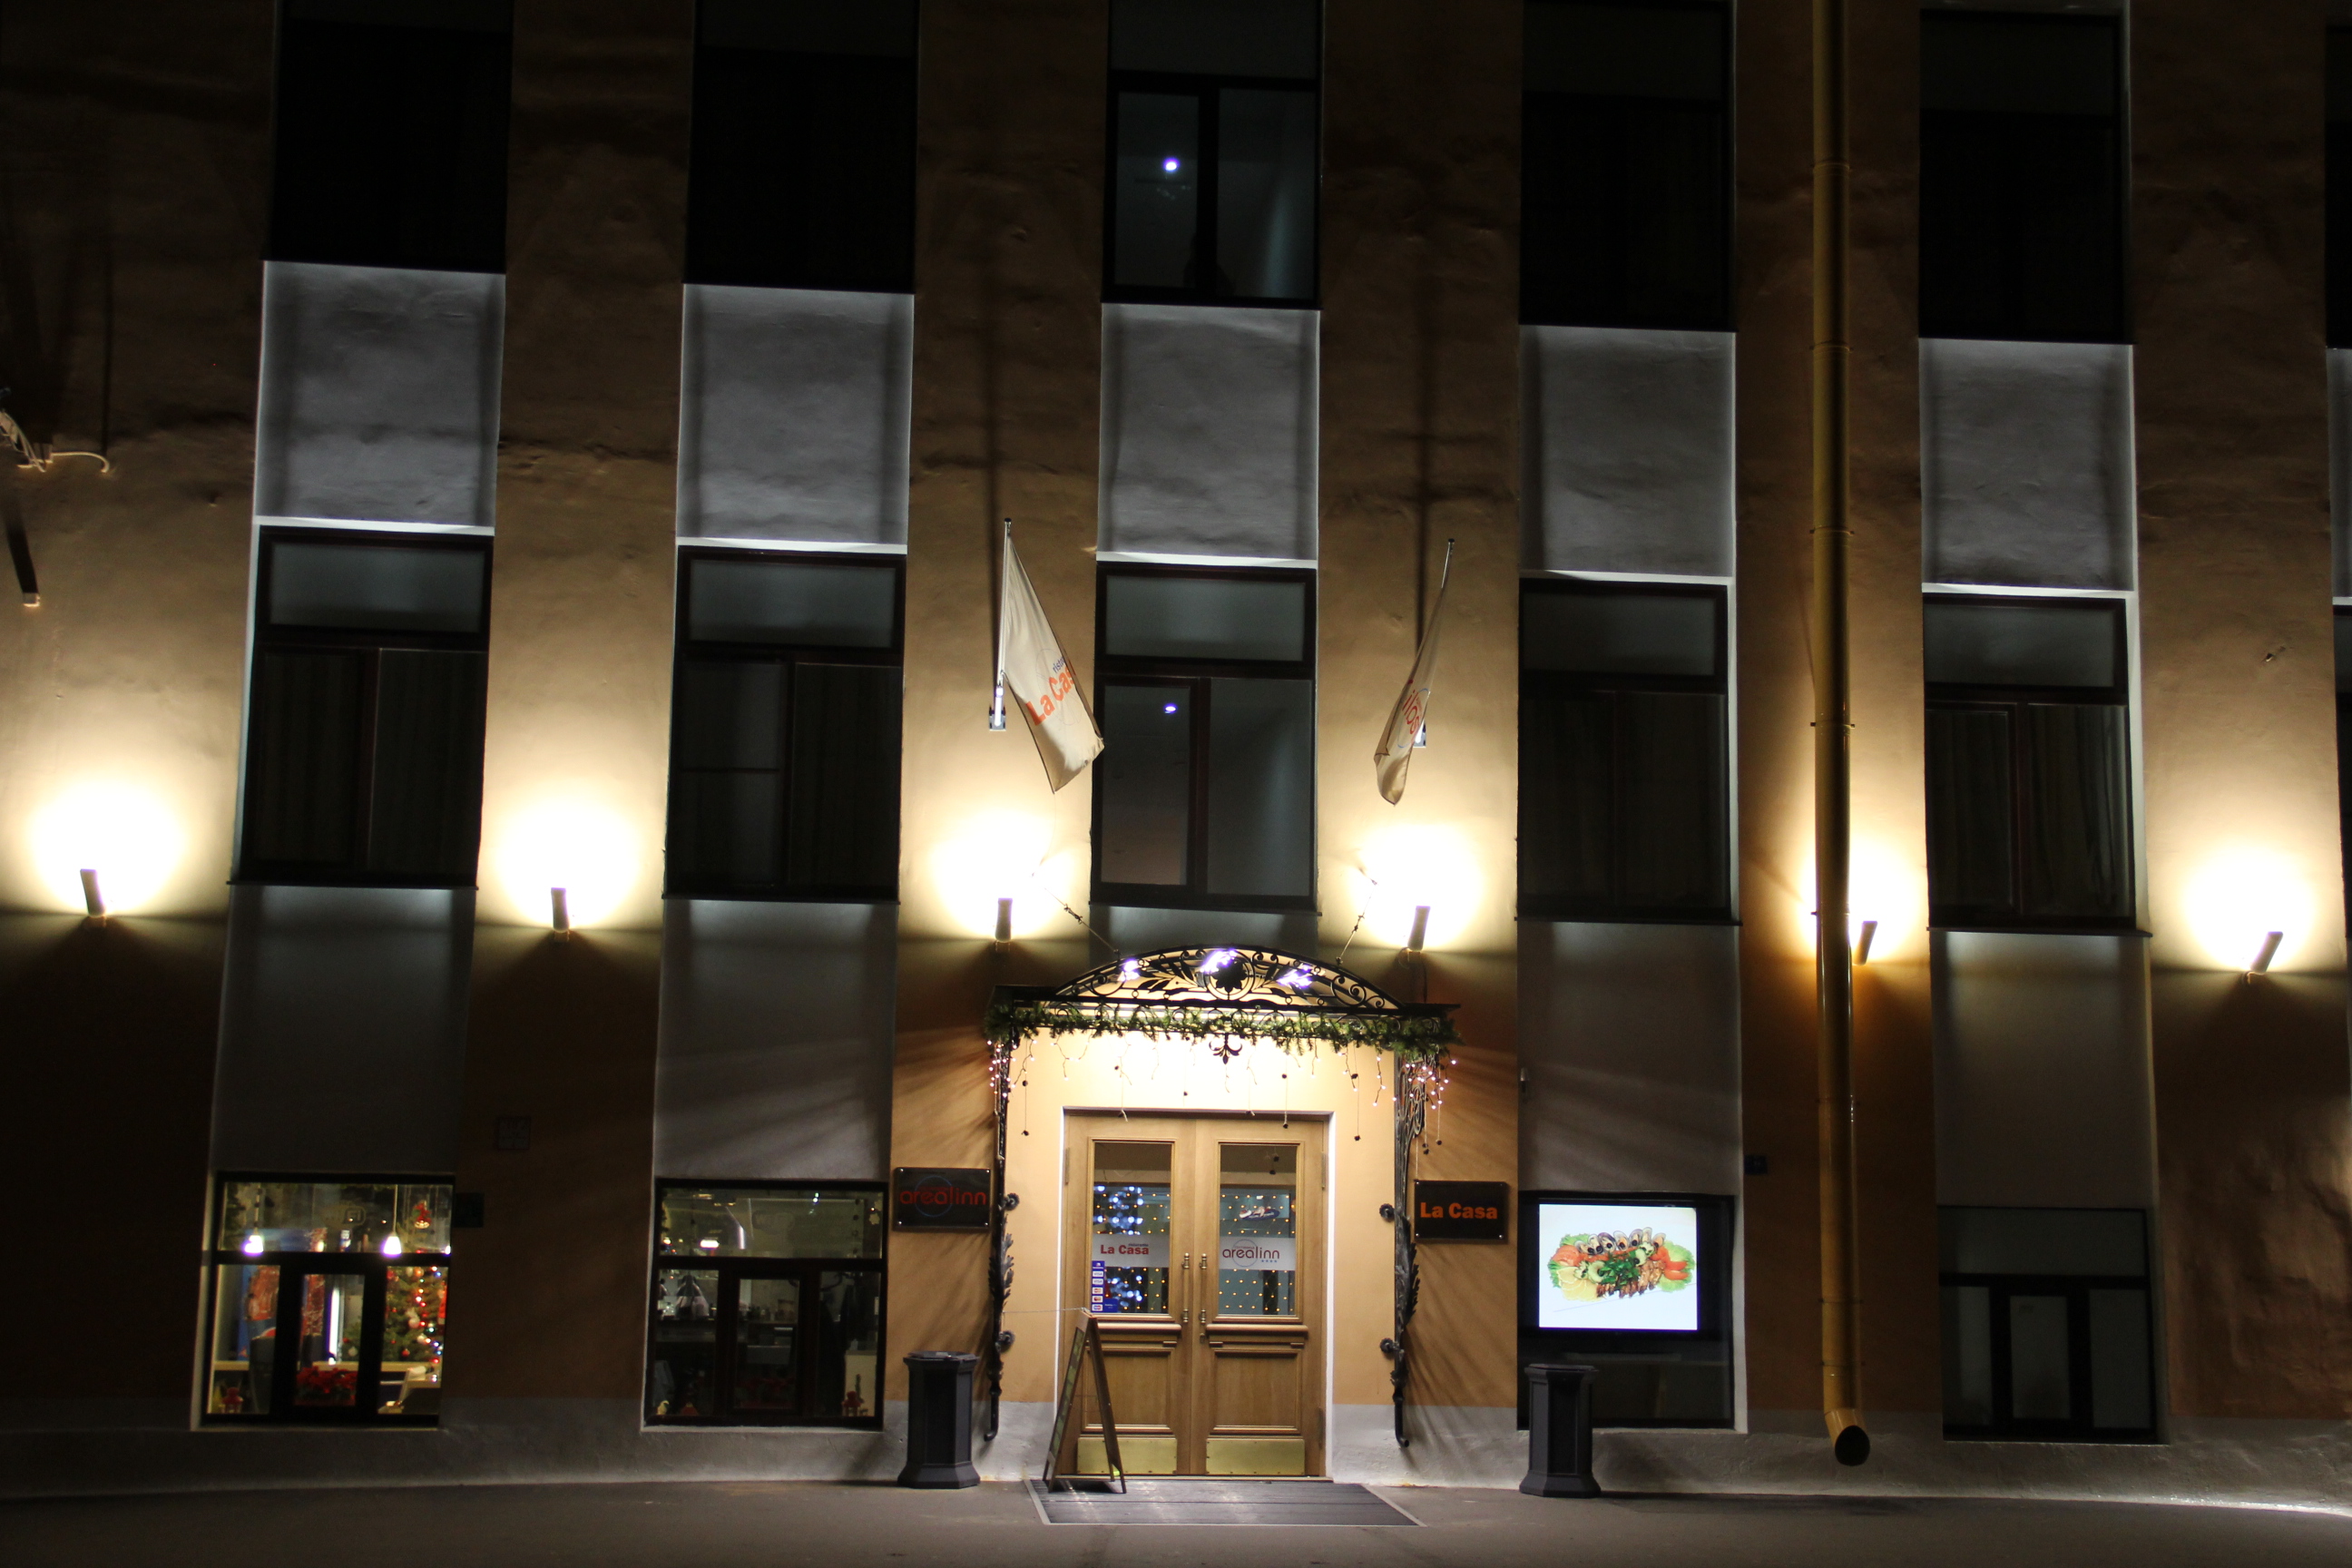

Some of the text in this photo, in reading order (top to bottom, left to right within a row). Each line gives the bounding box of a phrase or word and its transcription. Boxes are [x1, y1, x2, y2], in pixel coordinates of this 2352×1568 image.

[1025, 665, 1074, 726] La Cas
[899, 1186, 987, 1205] arealinn
[1420, 1201, 1499, 1220] La Casa
[1101, 1245, 1115, 1254] La
[1118, 1244, 1150, 1255] Casa
[1222, 1246, 1280, 1259] arealinn
